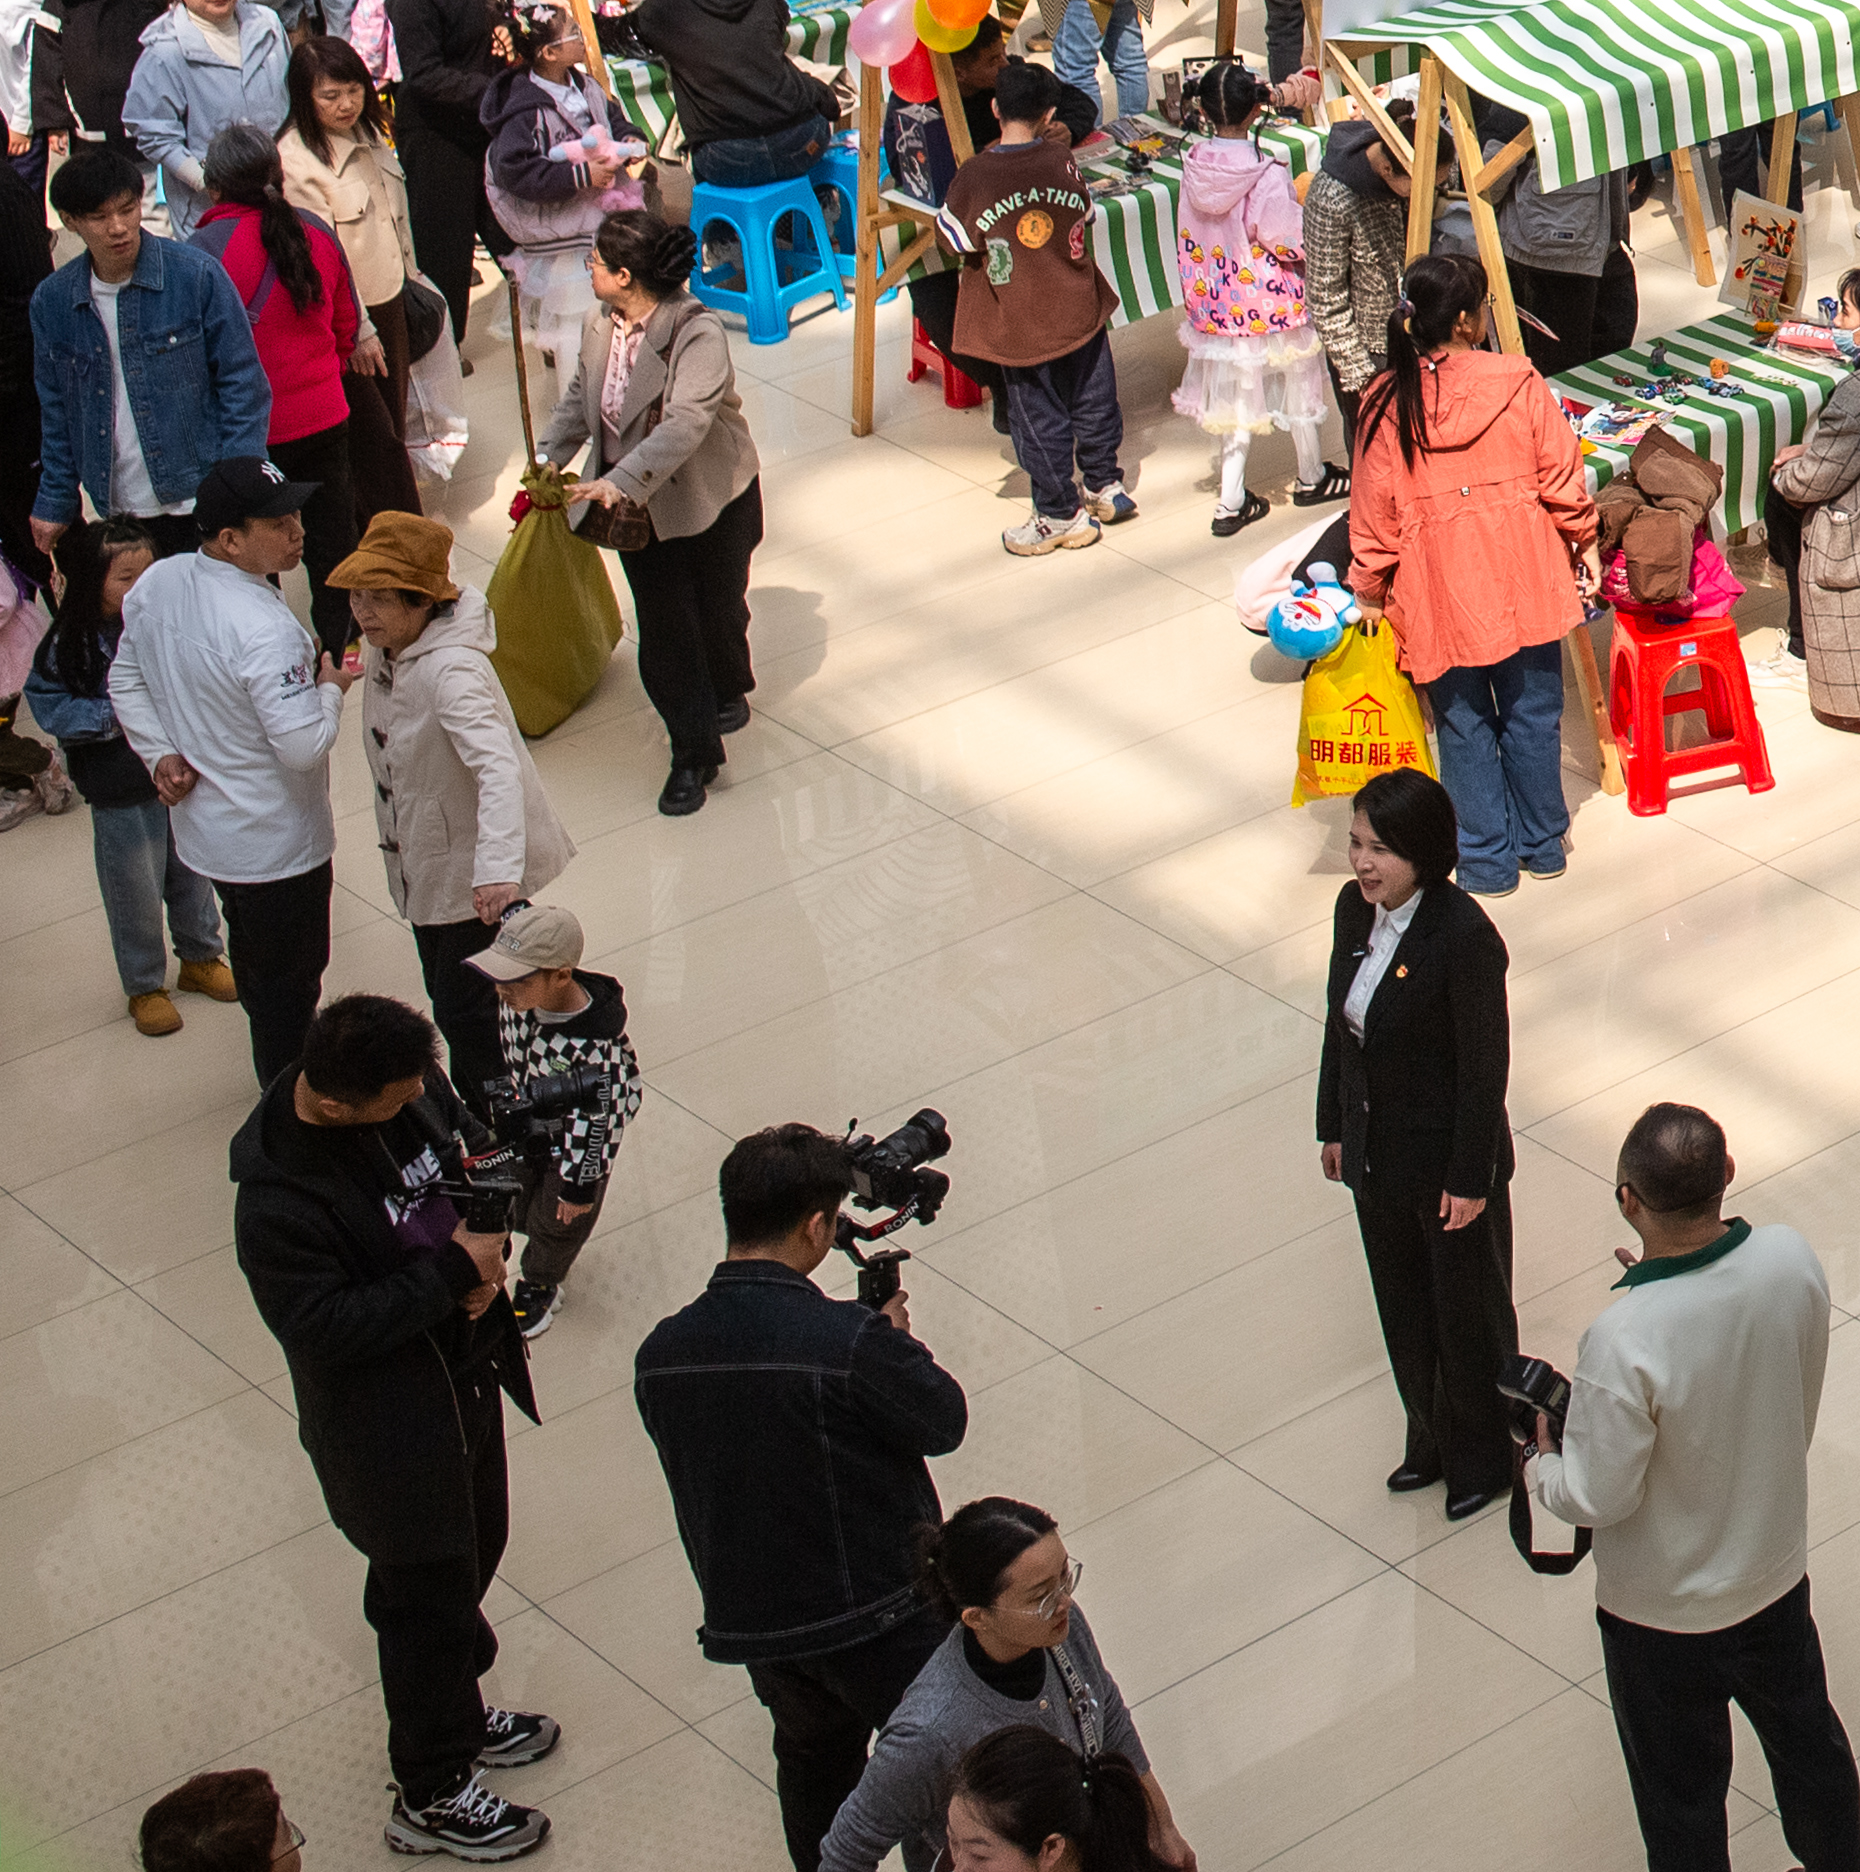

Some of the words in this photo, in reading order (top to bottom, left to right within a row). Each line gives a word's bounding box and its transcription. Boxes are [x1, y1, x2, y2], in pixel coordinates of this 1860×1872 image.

[1309, 739, 1419, 766] 明都服装
[474, 1149, 515, 1170] RONIN
[875, 1201, 919, 1233] RONIN
